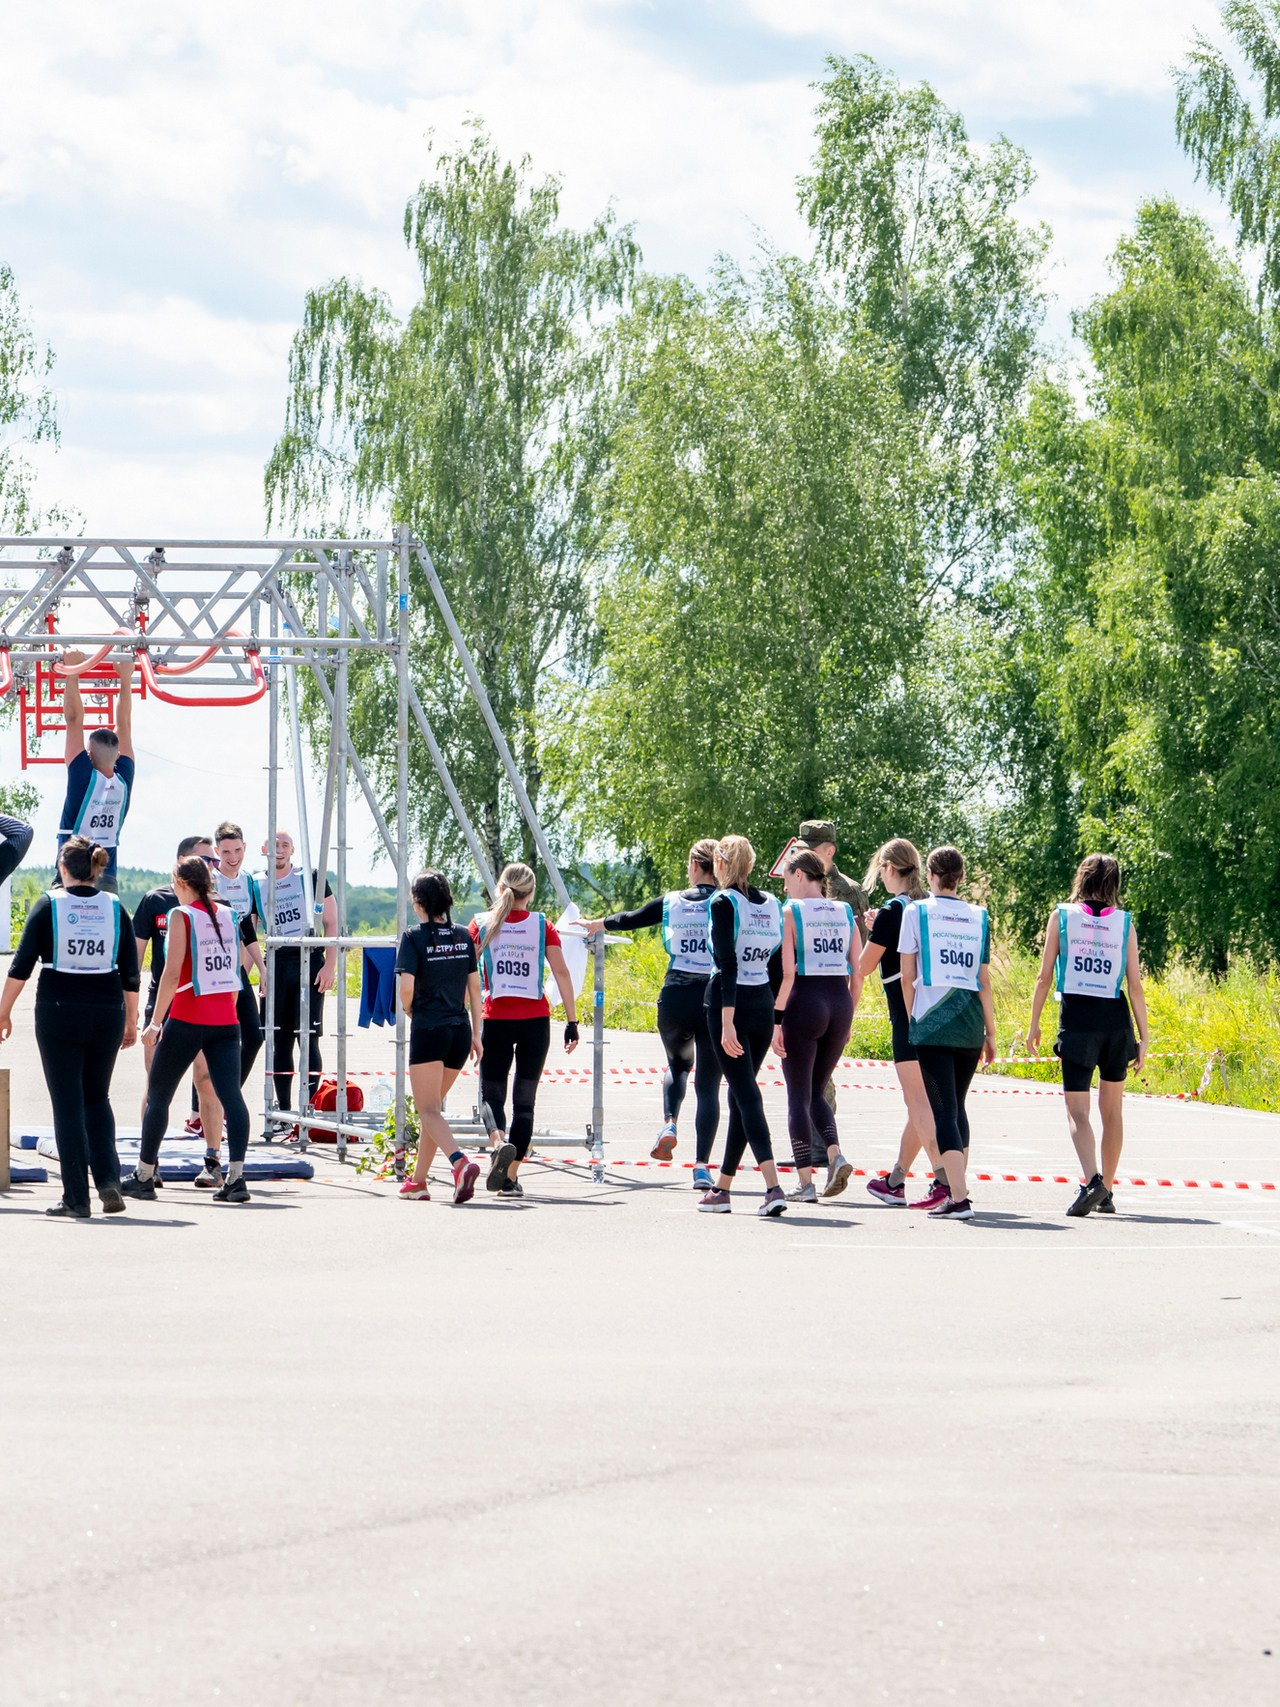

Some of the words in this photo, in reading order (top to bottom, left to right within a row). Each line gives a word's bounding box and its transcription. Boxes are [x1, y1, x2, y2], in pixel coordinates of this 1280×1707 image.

[67, 939, 105, 956] 5784
[681, 939, 708, 953] 504
[813, 938, 843, 953] 5048
[940, 949, 974, 968] 5040
[1074, 956, 1112, 975] 5039
[496, 960, 530, 977] 6039
